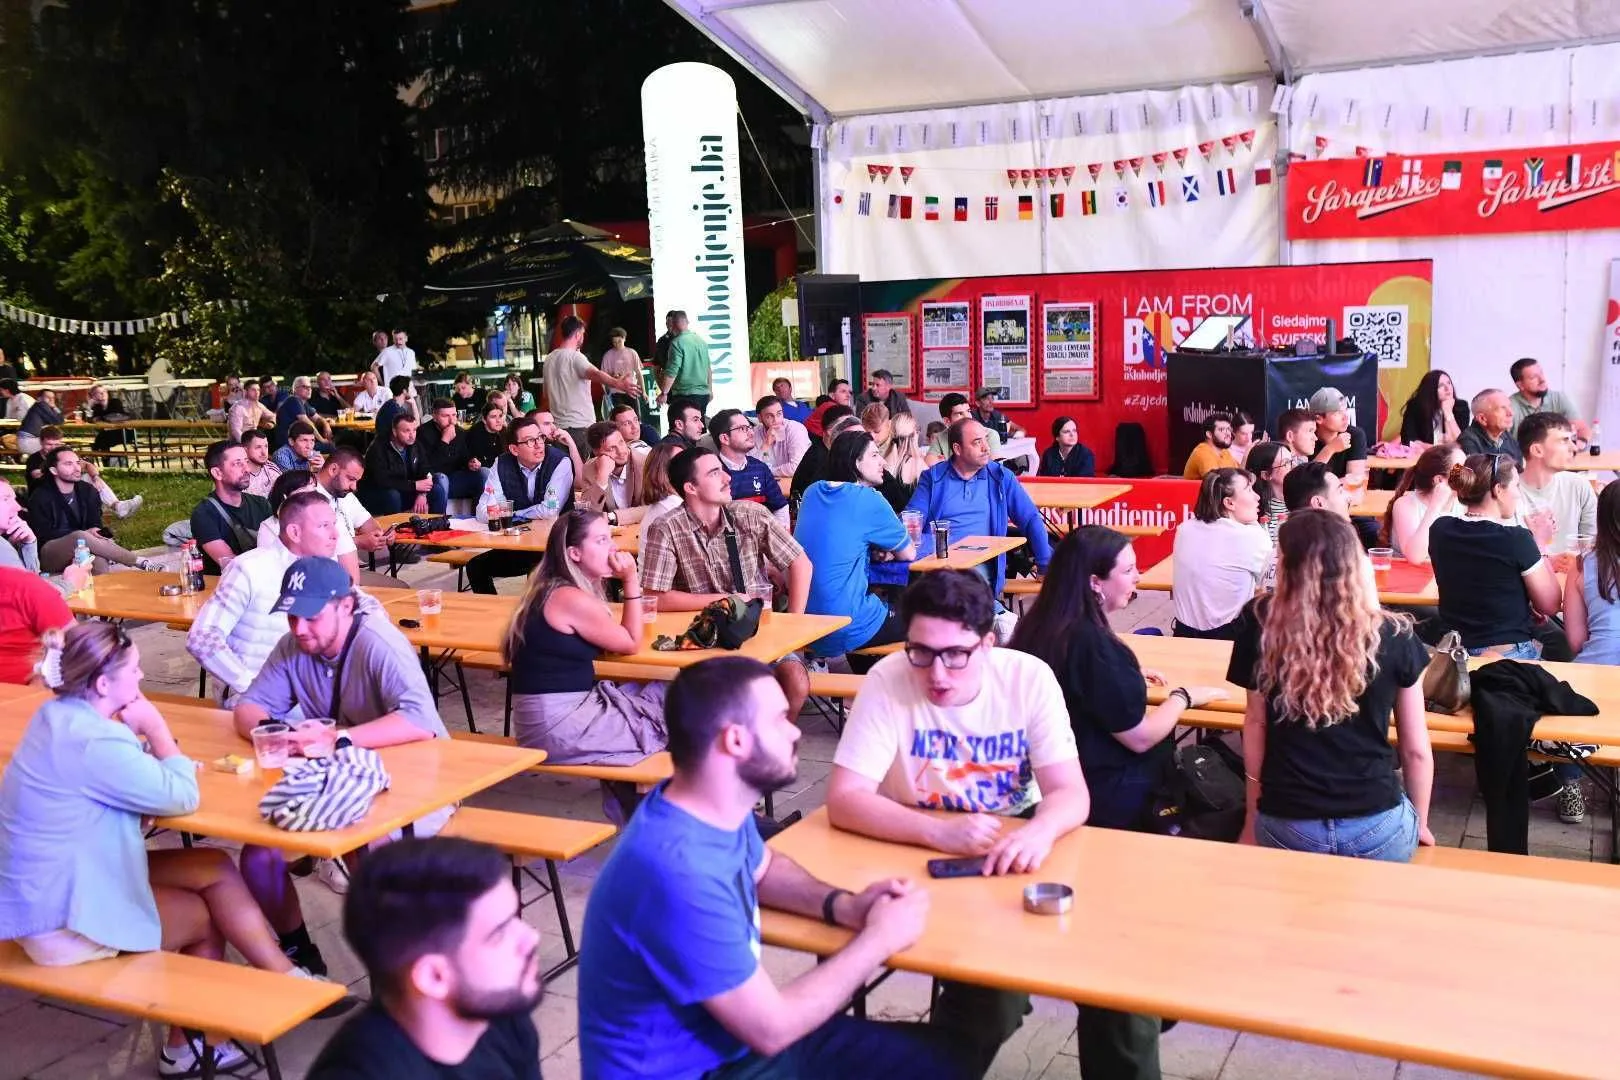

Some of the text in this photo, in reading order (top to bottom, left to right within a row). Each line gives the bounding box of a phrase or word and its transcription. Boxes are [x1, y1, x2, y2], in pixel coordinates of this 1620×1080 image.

[1123, 294, 1253, 316] I AM FROM
[1272, 314, 1327, 329] Gledajmo
[1123, 369, 1168, 383] oslobodje
[1123, 394, 1168, 411] #Zajedn
[910, 728, 959, 761] NEW
